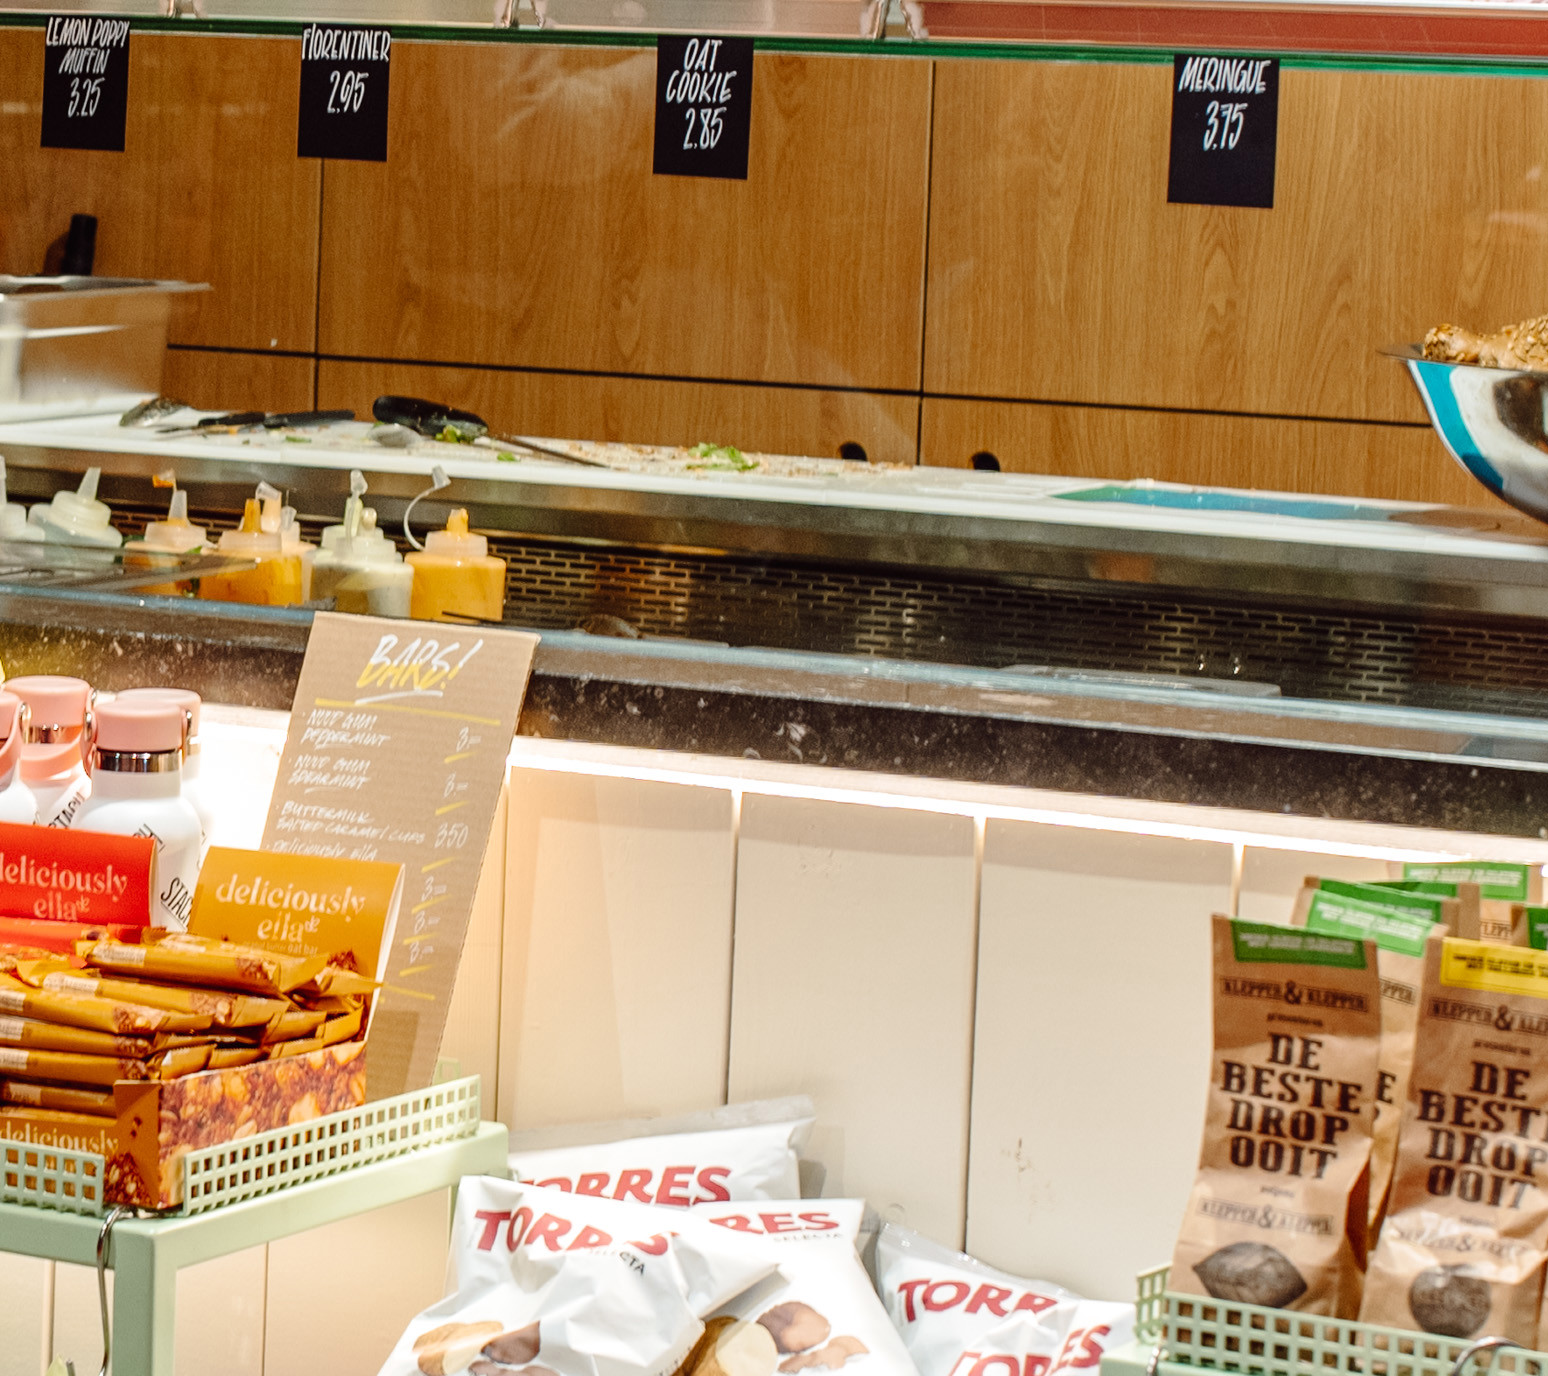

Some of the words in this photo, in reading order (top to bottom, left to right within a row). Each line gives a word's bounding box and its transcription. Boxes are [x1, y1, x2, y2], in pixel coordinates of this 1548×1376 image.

[46, 17, 89, 47] LEMON
[91, 20, 130, 47] POPPY
[59, 48, 110, 74] MUFFIN
[684, 38, 722, 72] OAT
[327, 70, 369, 114] 2.95
[666, 70, 737, 104] COOKIE
[1178, 56, 1270, 96] MERINGUE
[68, 77, 105, 118] 3.25
[682, 107, 727, 150] 2.85
[1202, 100, 1245, 152] 3.75
[356, 634, 483, 690] BARS!
[33, 895, 75, 922] ella
[1268, 1033, 1323, 1071] DE
[1221, 1061, 1362, 1113] BESTE
[1227, 1099, 1349, 1146] DROP
[1229, 1137, 1338, 1179] OOIT
